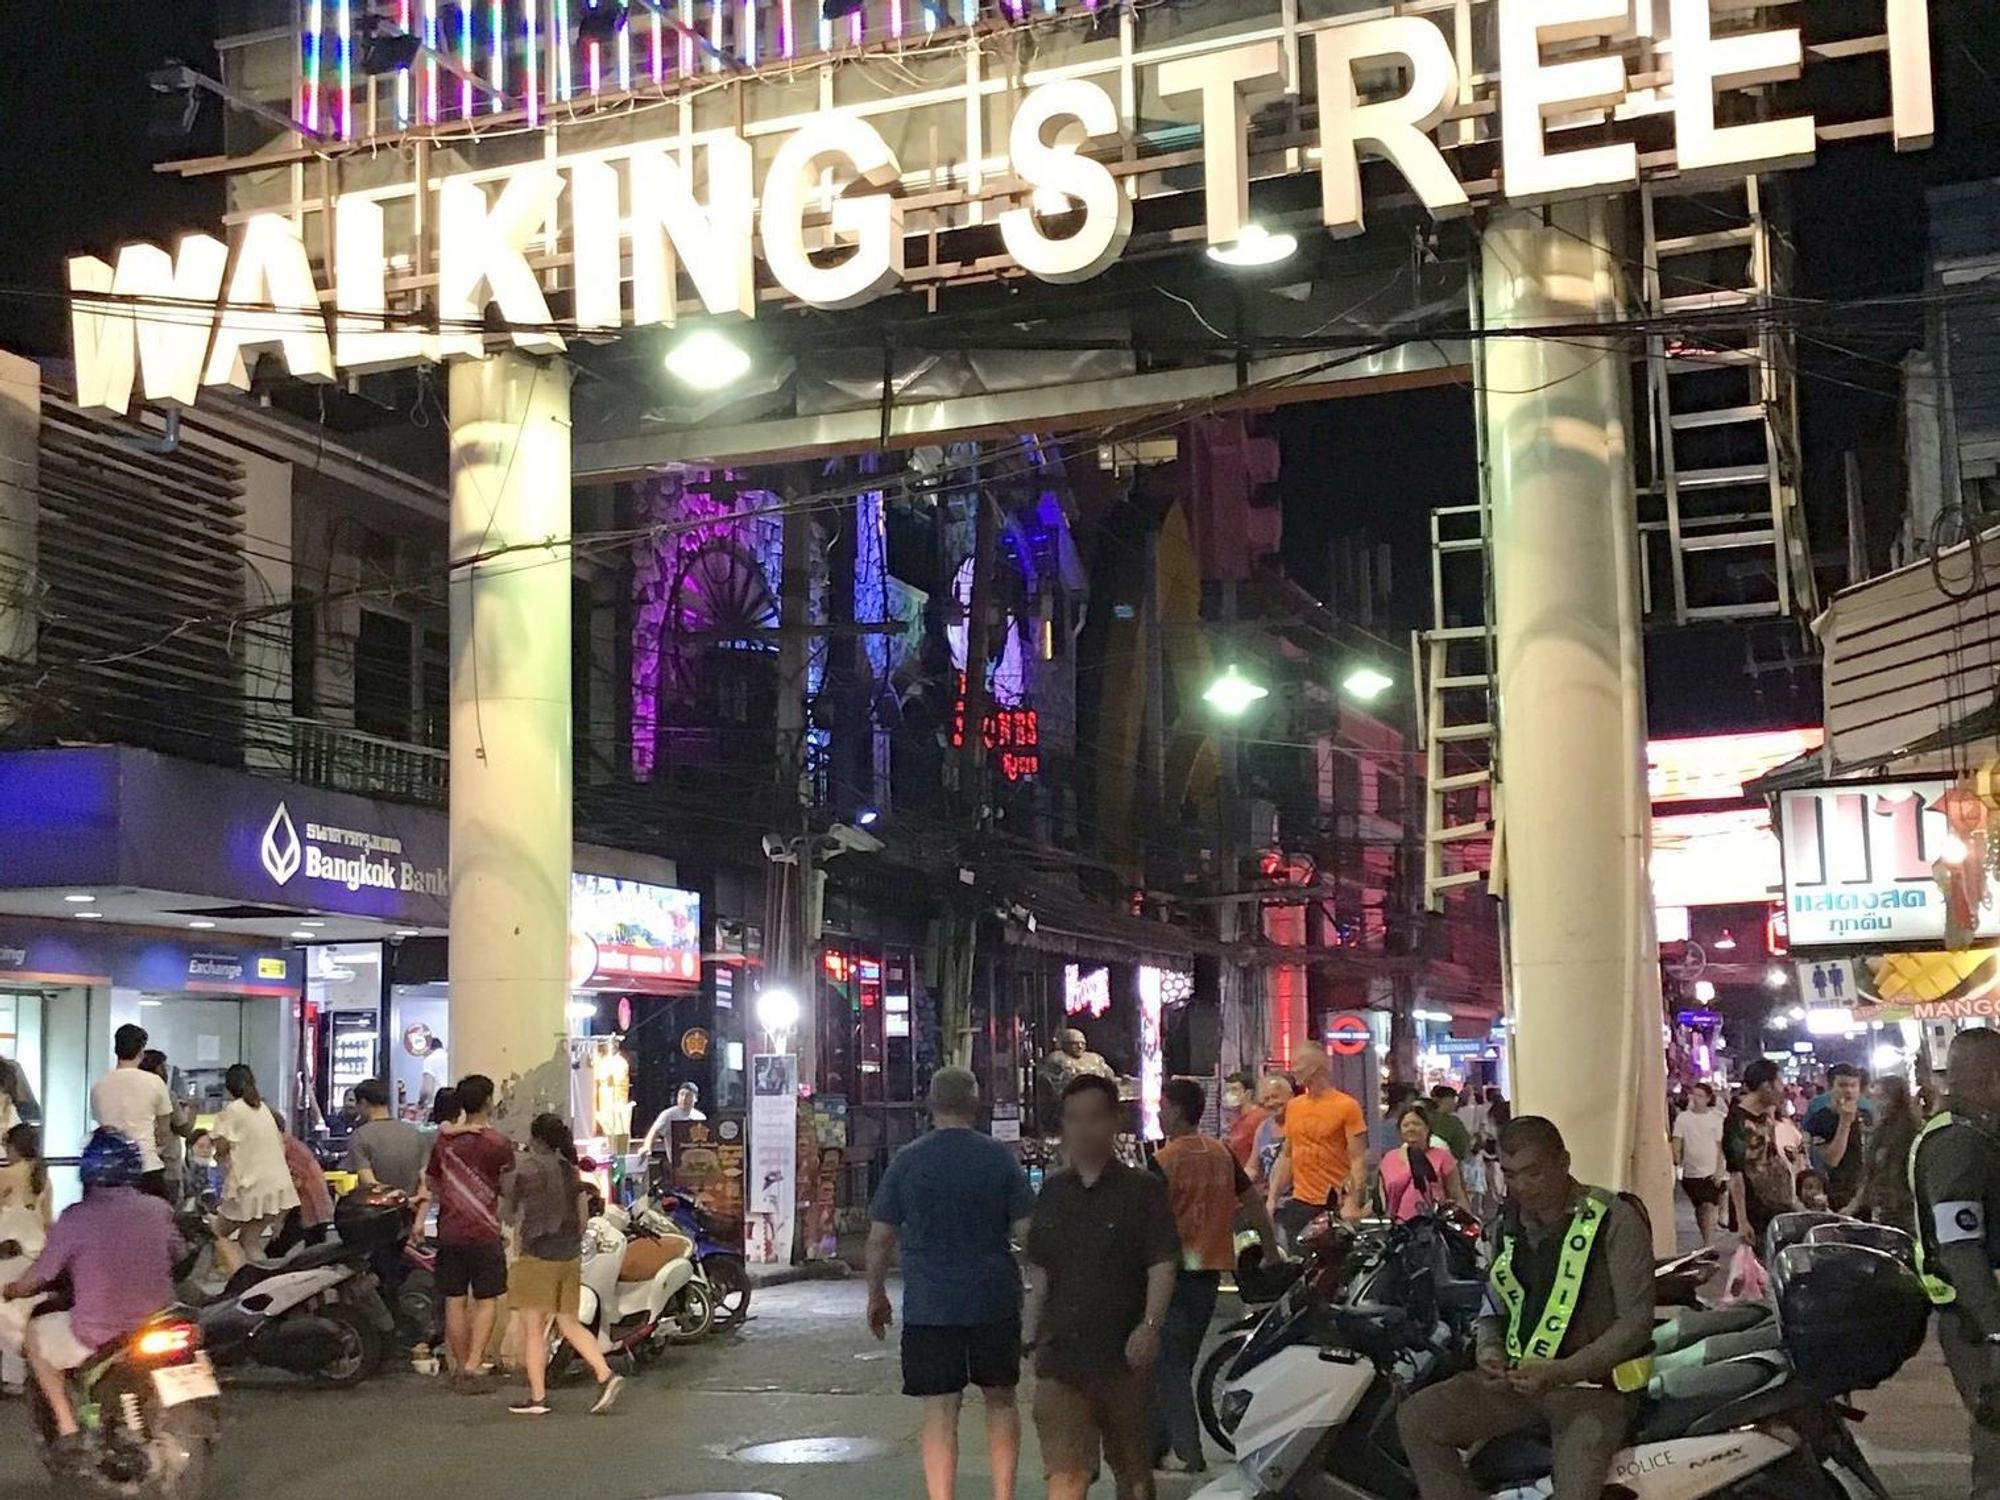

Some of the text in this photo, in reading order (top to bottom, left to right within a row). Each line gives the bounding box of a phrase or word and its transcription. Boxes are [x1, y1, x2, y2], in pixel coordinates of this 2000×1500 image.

[69, 112, 903, 414] WALKING
[305, 846, 449, 896] Bangkok Bank
[189, 959, 243, 979] Exchange
[1532, 1208, 1597, 1358] POLICE
[1616, 1450, 1676, 1477] POLICE
